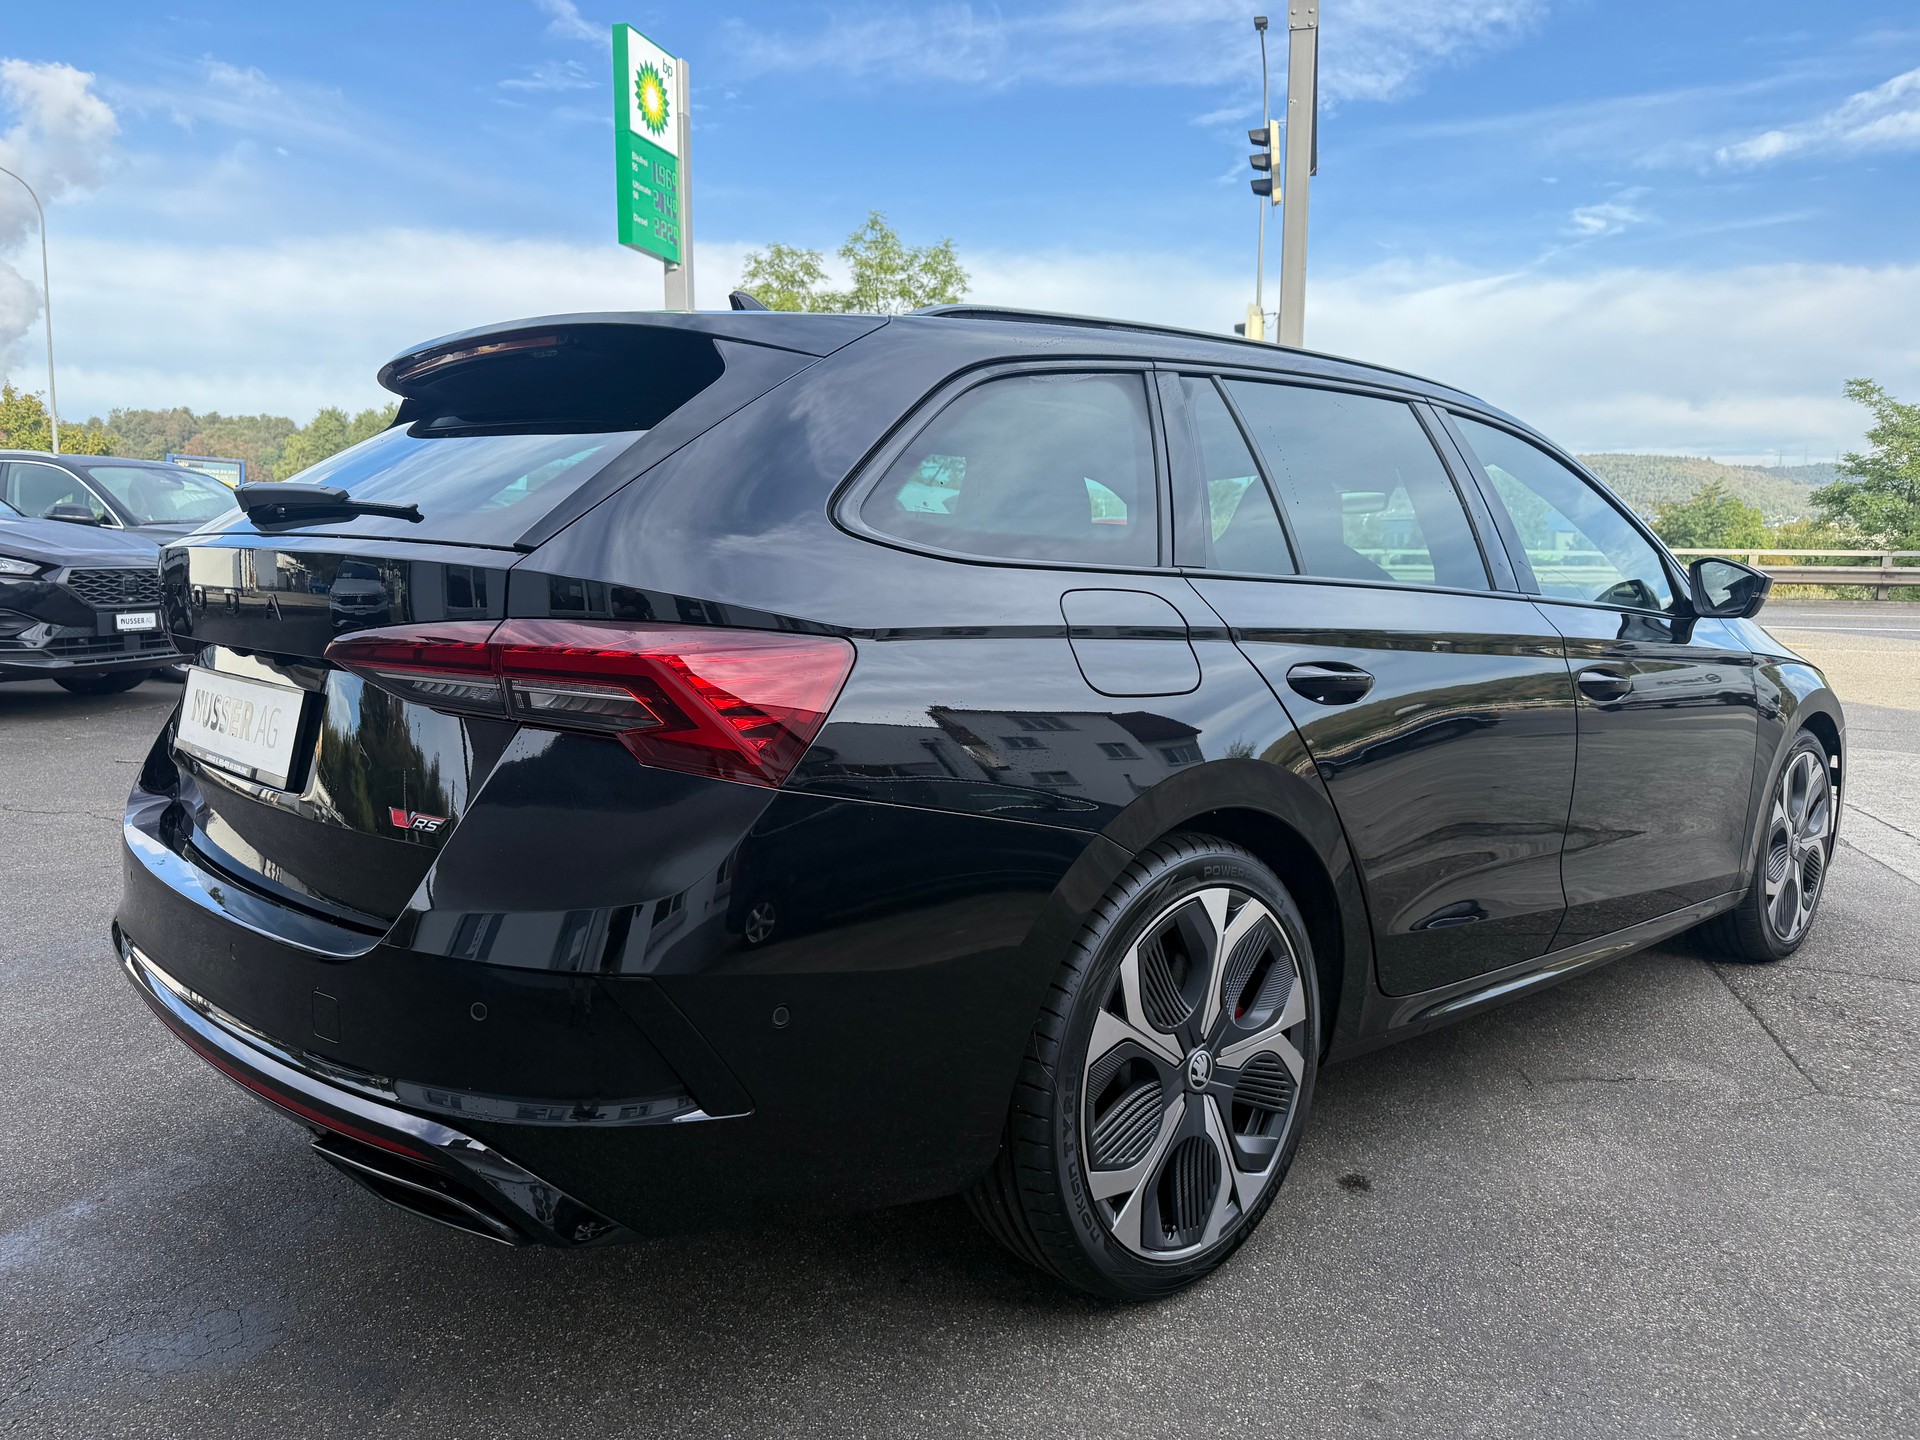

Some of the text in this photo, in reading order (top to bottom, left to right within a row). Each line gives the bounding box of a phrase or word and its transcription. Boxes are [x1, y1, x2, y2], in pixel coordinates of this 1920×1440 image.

[662, 58, 673, 79] bp
[633, 213, 648, 227] Diesel
[121, 617, 145, 625] NUSSER
[190, 688, 282, 749] NUSSER AG
